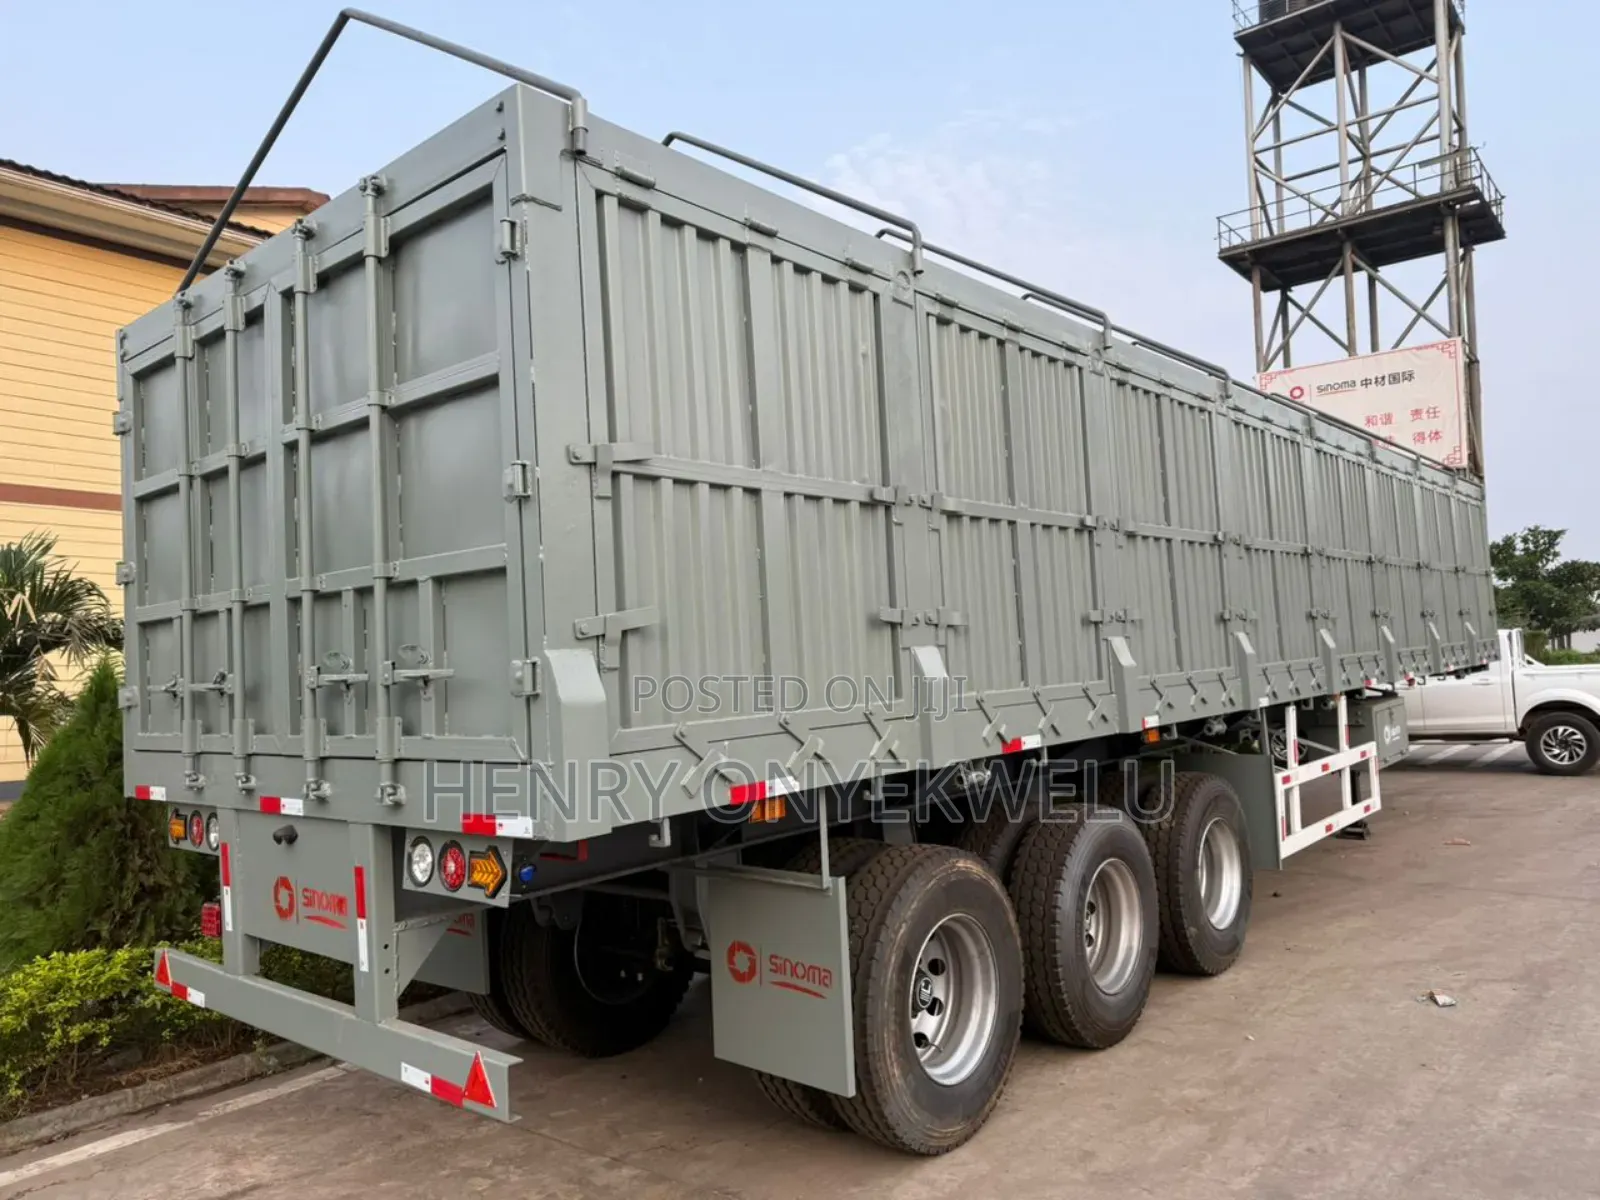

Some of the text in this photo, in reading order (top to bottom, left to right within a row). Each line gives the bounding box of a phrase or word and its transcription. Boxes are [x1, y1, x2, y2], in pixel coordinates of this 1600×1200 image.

[1360, 371, 1414, 388] 中材国际
[1365, 406, 1440, 427] 和谐 责任
[1412, 429, 1442, 445] 得体
[769, 954, 832, 988] sinoma
